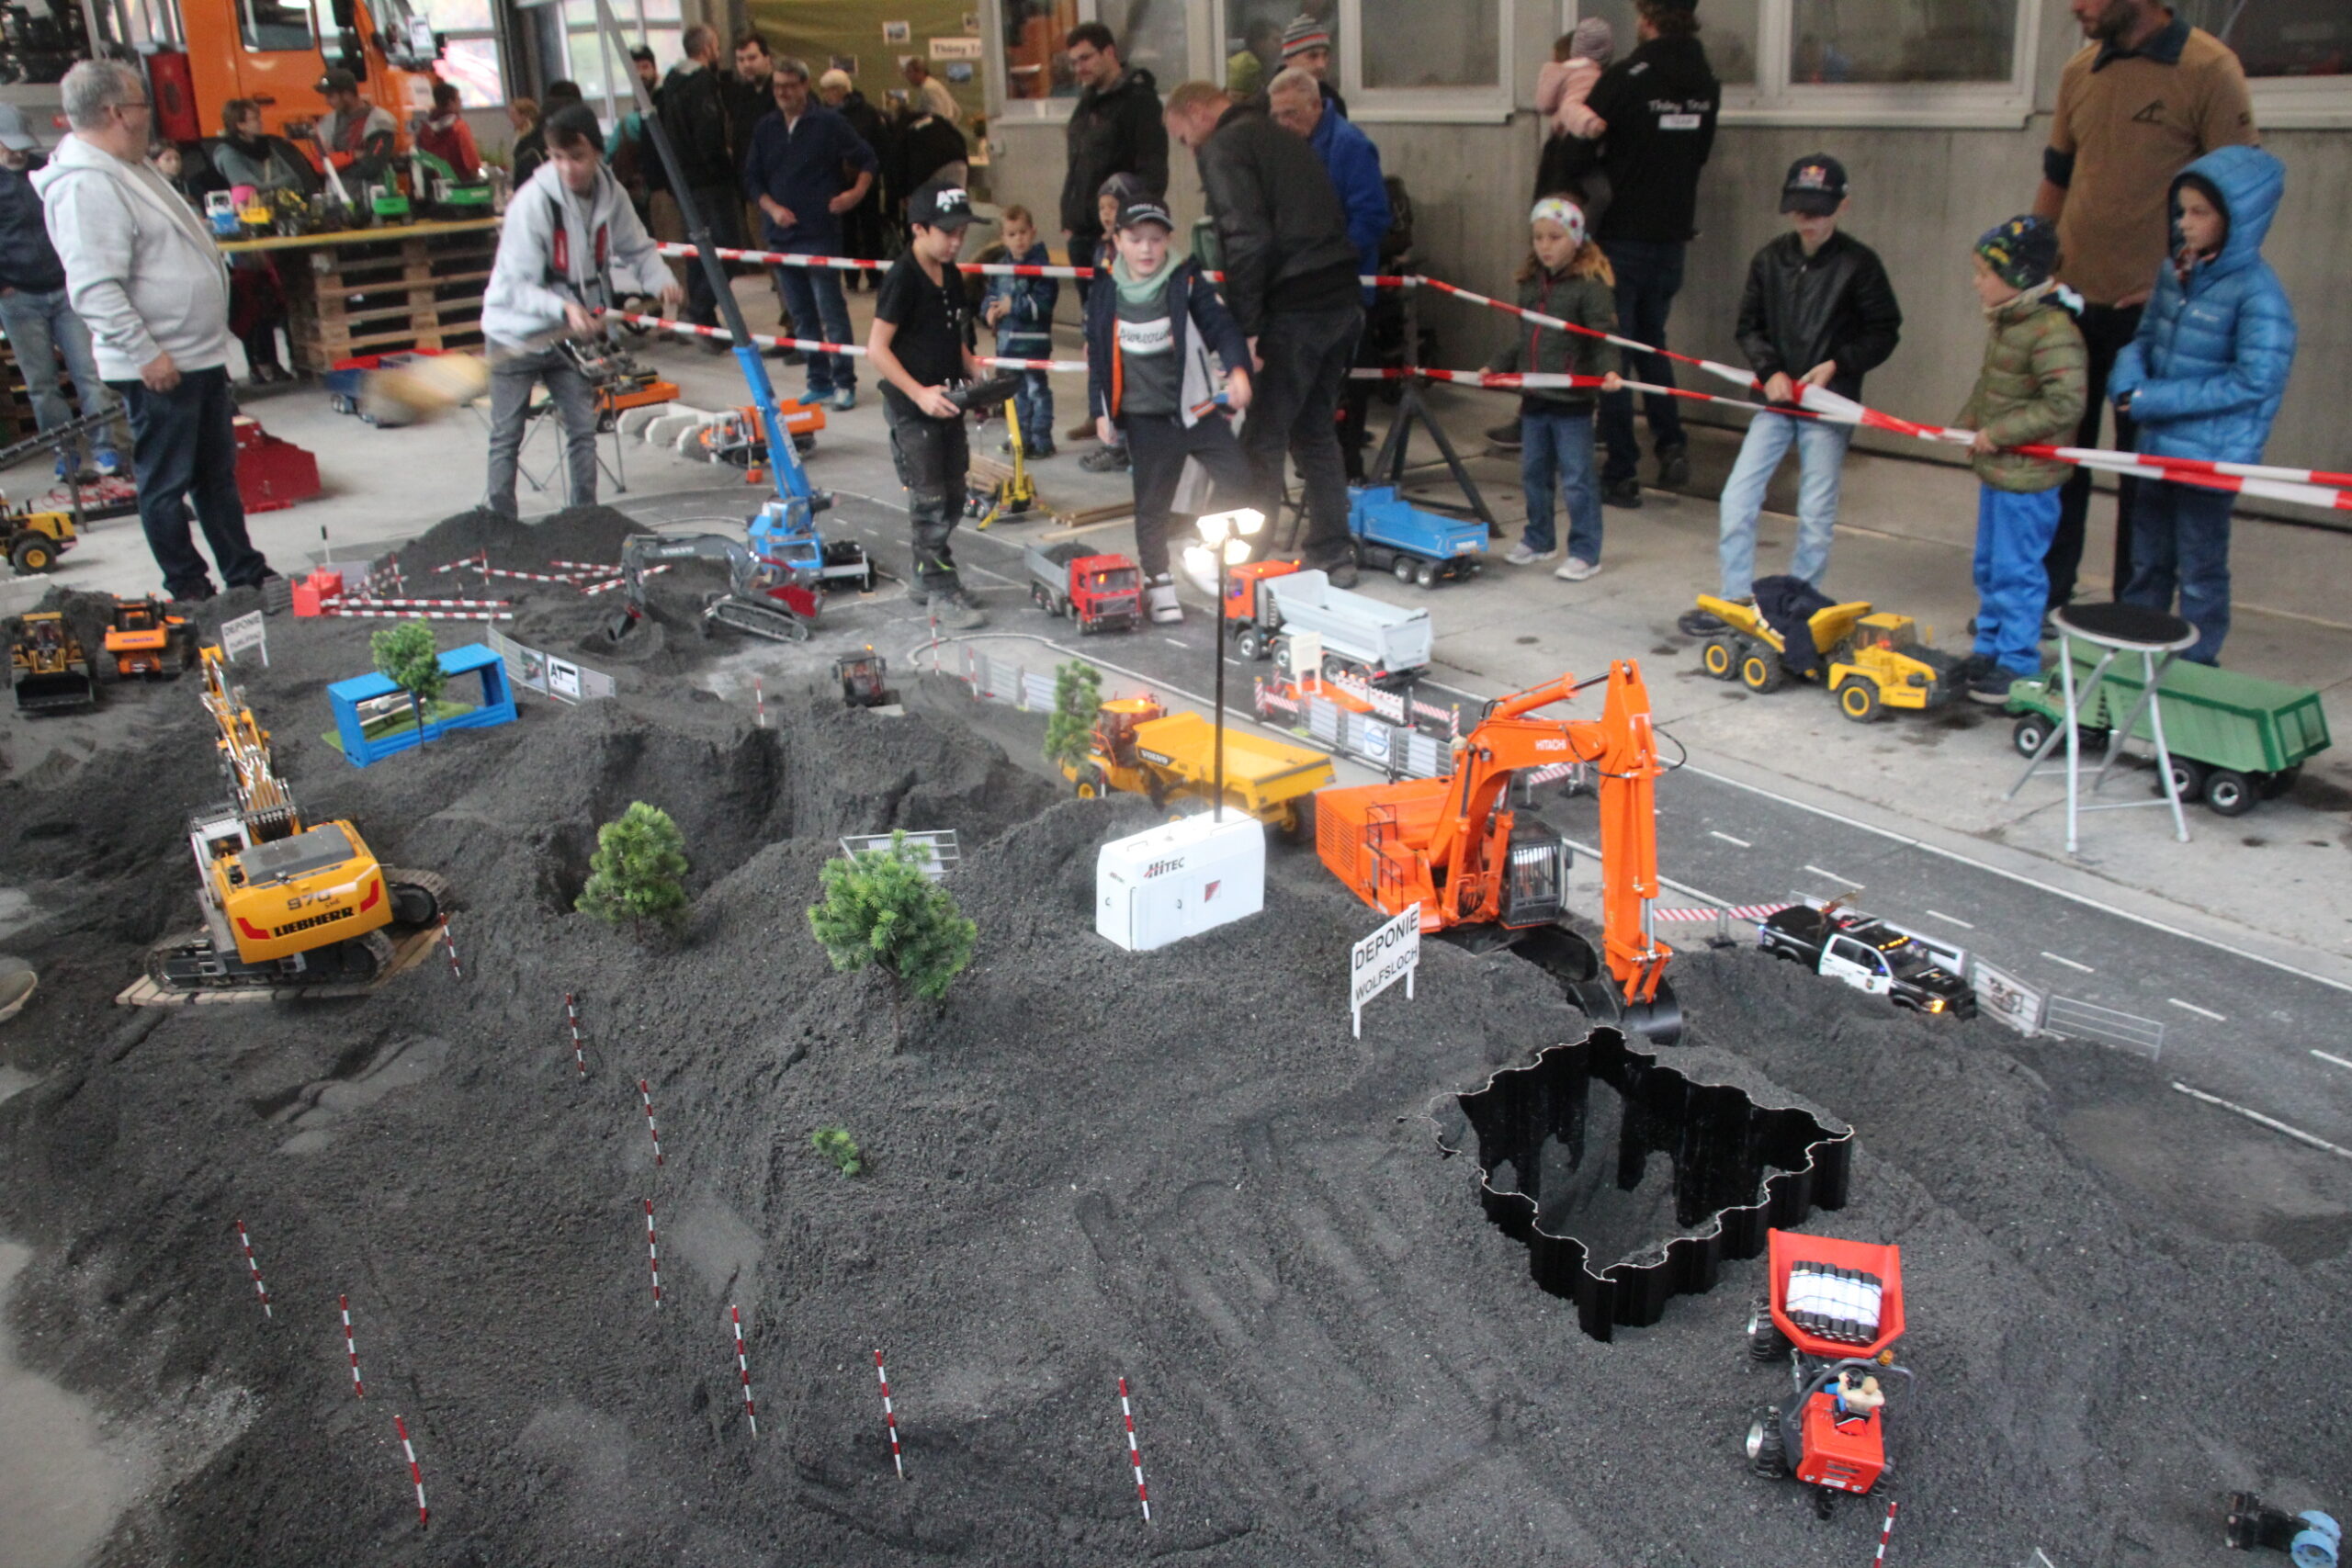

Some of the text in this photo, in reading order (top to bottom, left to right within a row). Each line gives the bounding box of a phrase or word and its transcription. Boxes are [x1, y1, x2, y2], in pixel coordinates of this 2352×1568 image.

[1140, 748, 1169, 766] VOLVO
[1535, 739, 1566, 750] HITACHI
[275, 907, 354, 937] LIEBHERR
[1355, 909, 1419, 971] DEPONIE
[1355, 944, 1419, 1002] WOLFSLOCH
